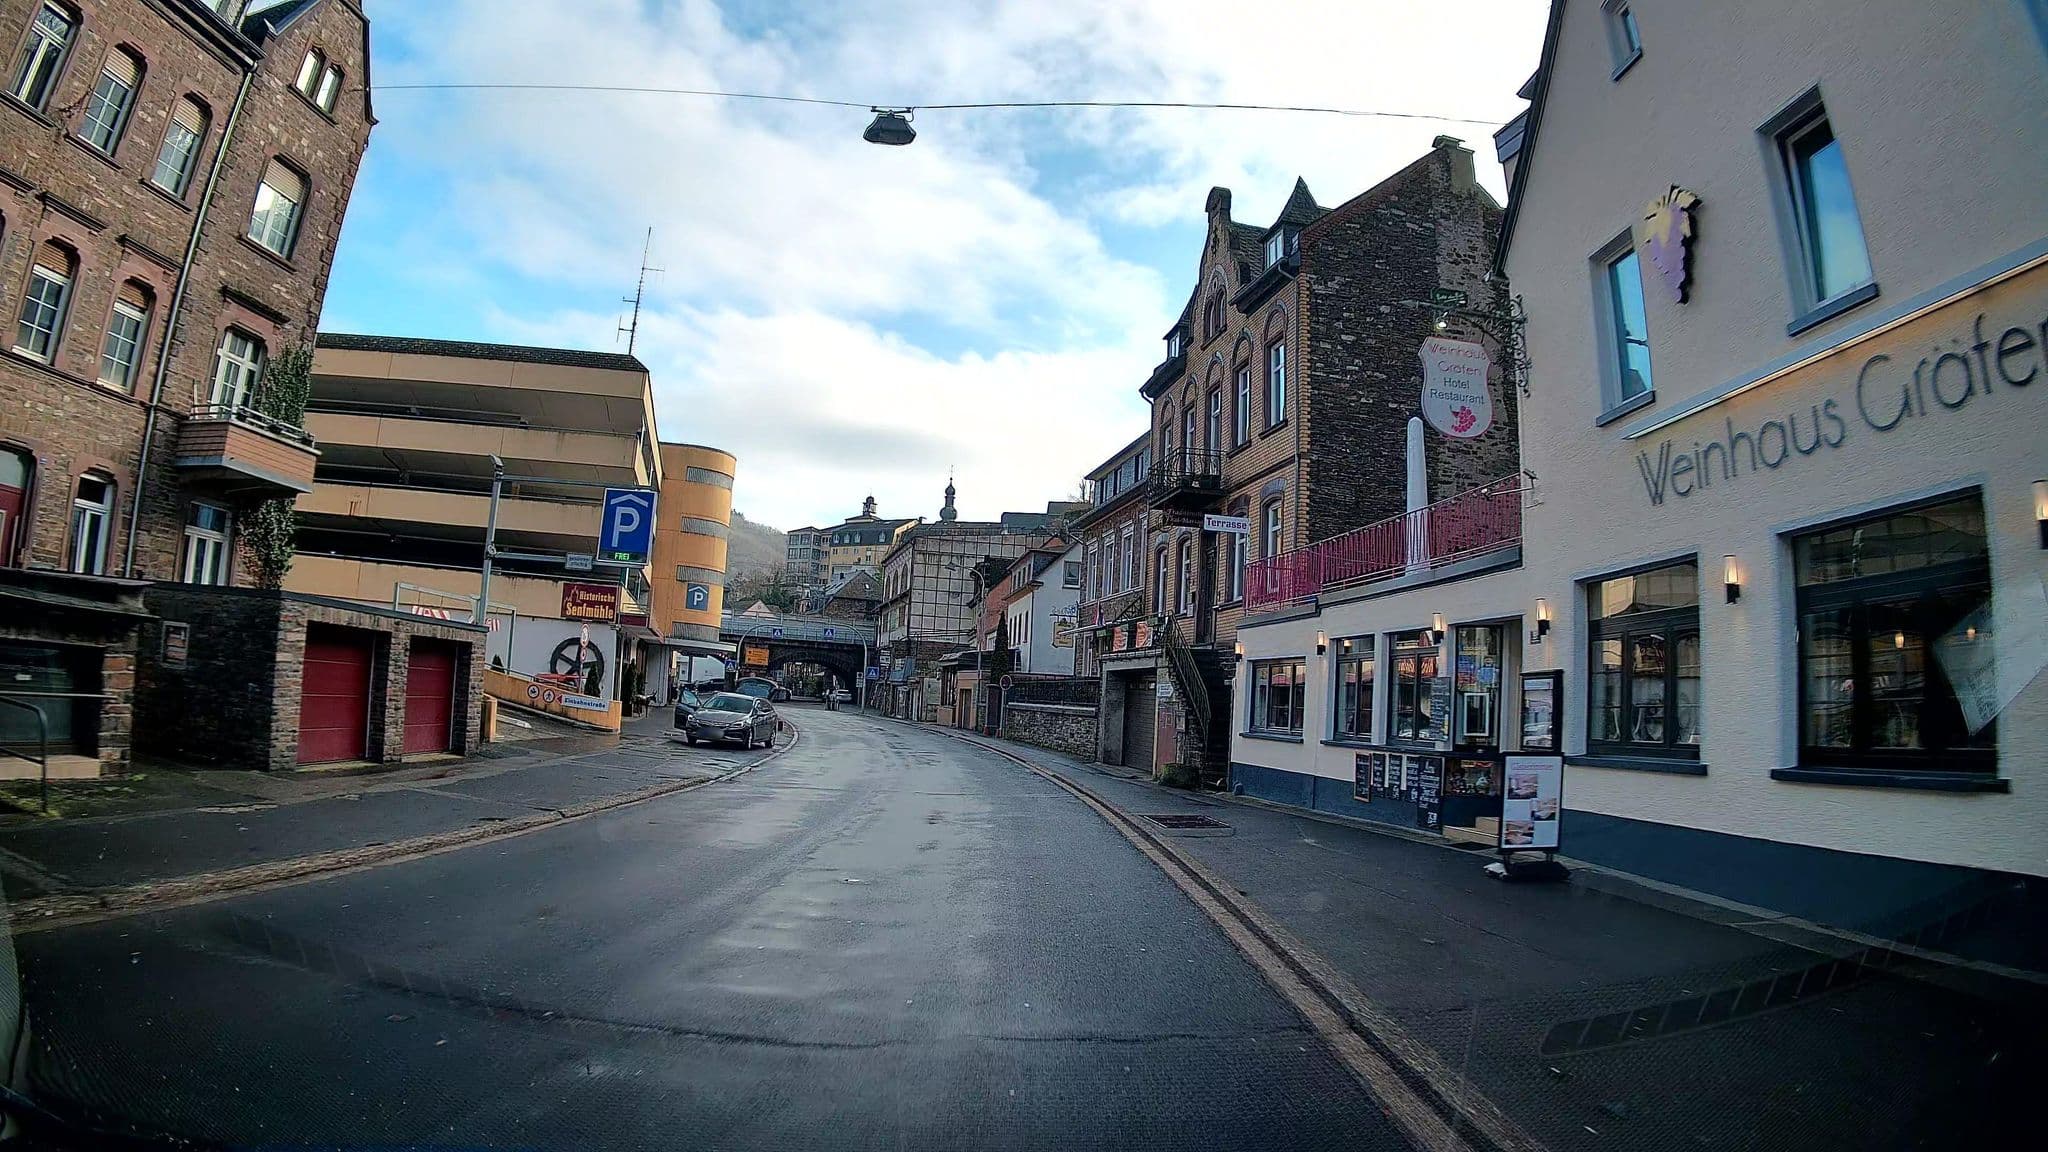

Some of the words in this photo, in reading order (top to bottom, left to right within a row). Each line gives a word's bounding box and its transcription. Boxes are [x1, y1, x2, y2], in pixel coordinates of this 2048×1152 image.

[1429, 344, 1486, 360] Weinhaus
[1443, 377, 1469, 388] Hotel
[1430, 389, 1484, 404] Restaurant
[1636, 398, 1846, 508] Weinhaus
[611, 506, 640, 547] P
[1206, 517, 1247, 530] Terrasse
[579, 591, 615, 602] Historische
[694, 592, 703, 605] P
[566, 602, 614, 619] Senfmühle
[564, 698, 605, 708] Einbahnstraße
